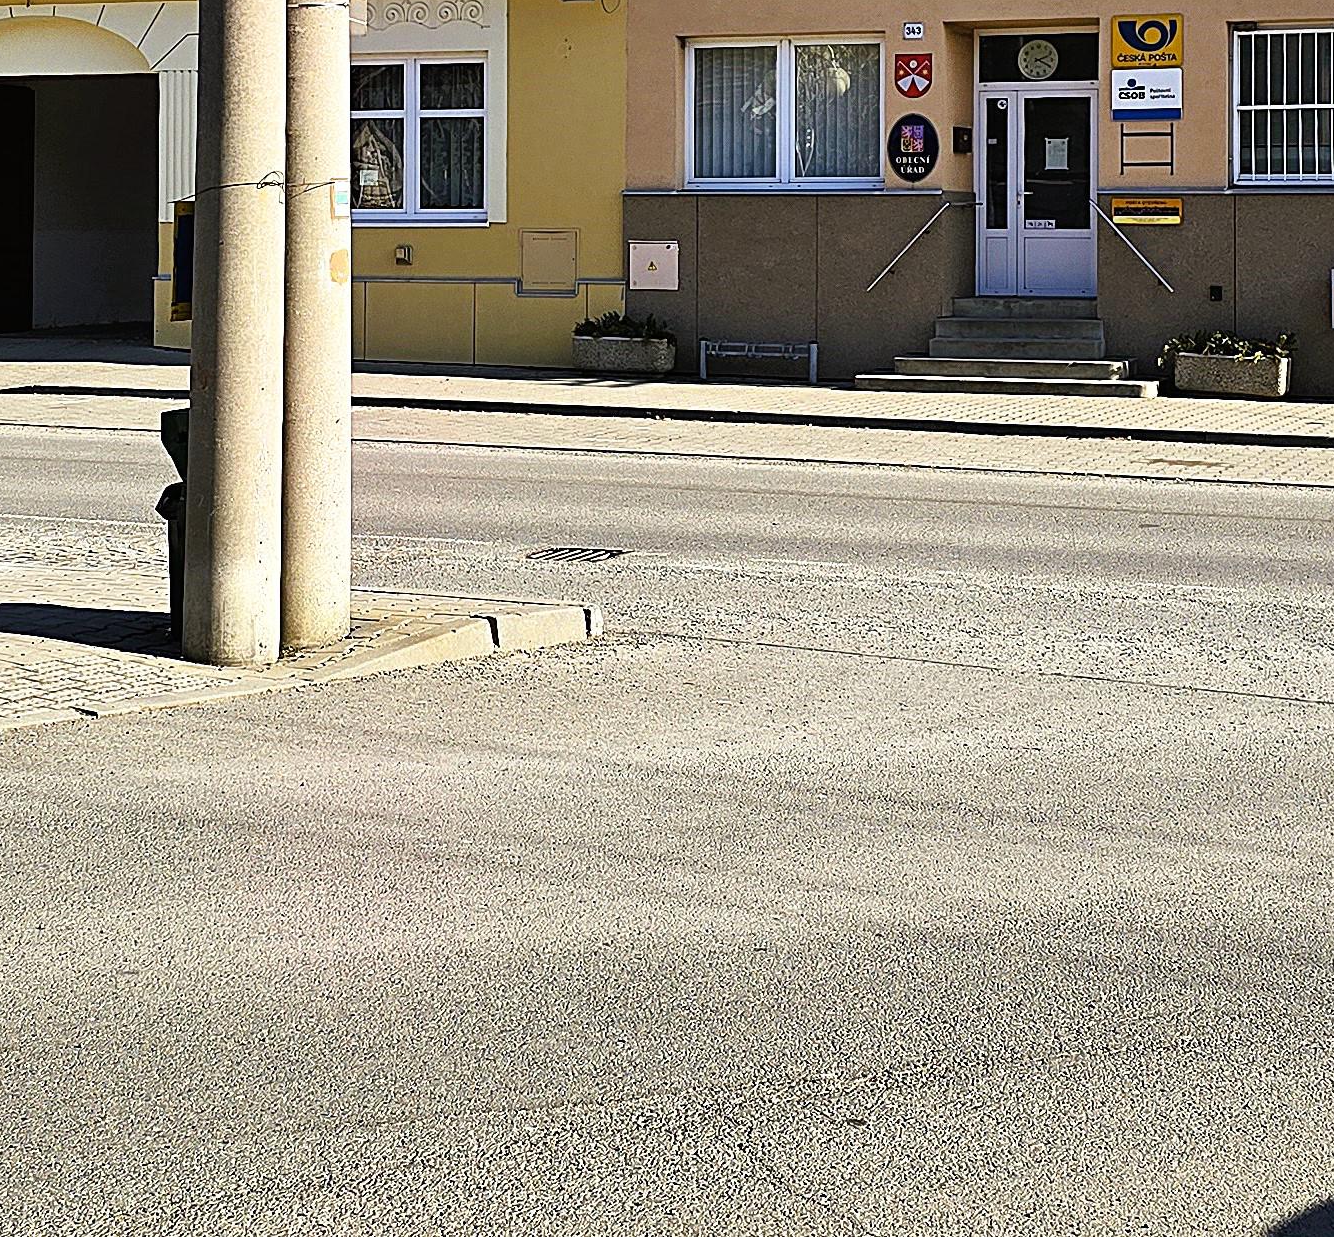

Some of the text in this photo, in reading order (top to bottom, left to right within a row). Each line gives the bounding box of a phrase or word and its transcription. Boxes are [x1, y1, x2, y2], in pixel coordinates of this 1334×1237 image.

[906, 26, 921, 35] 343
[1117, 52, 1177, 62] ČESKÁ POŠTA
[895, 155, 931, 164] OBECNÍ
[900, 164, 925, 174] ÚŘAD
